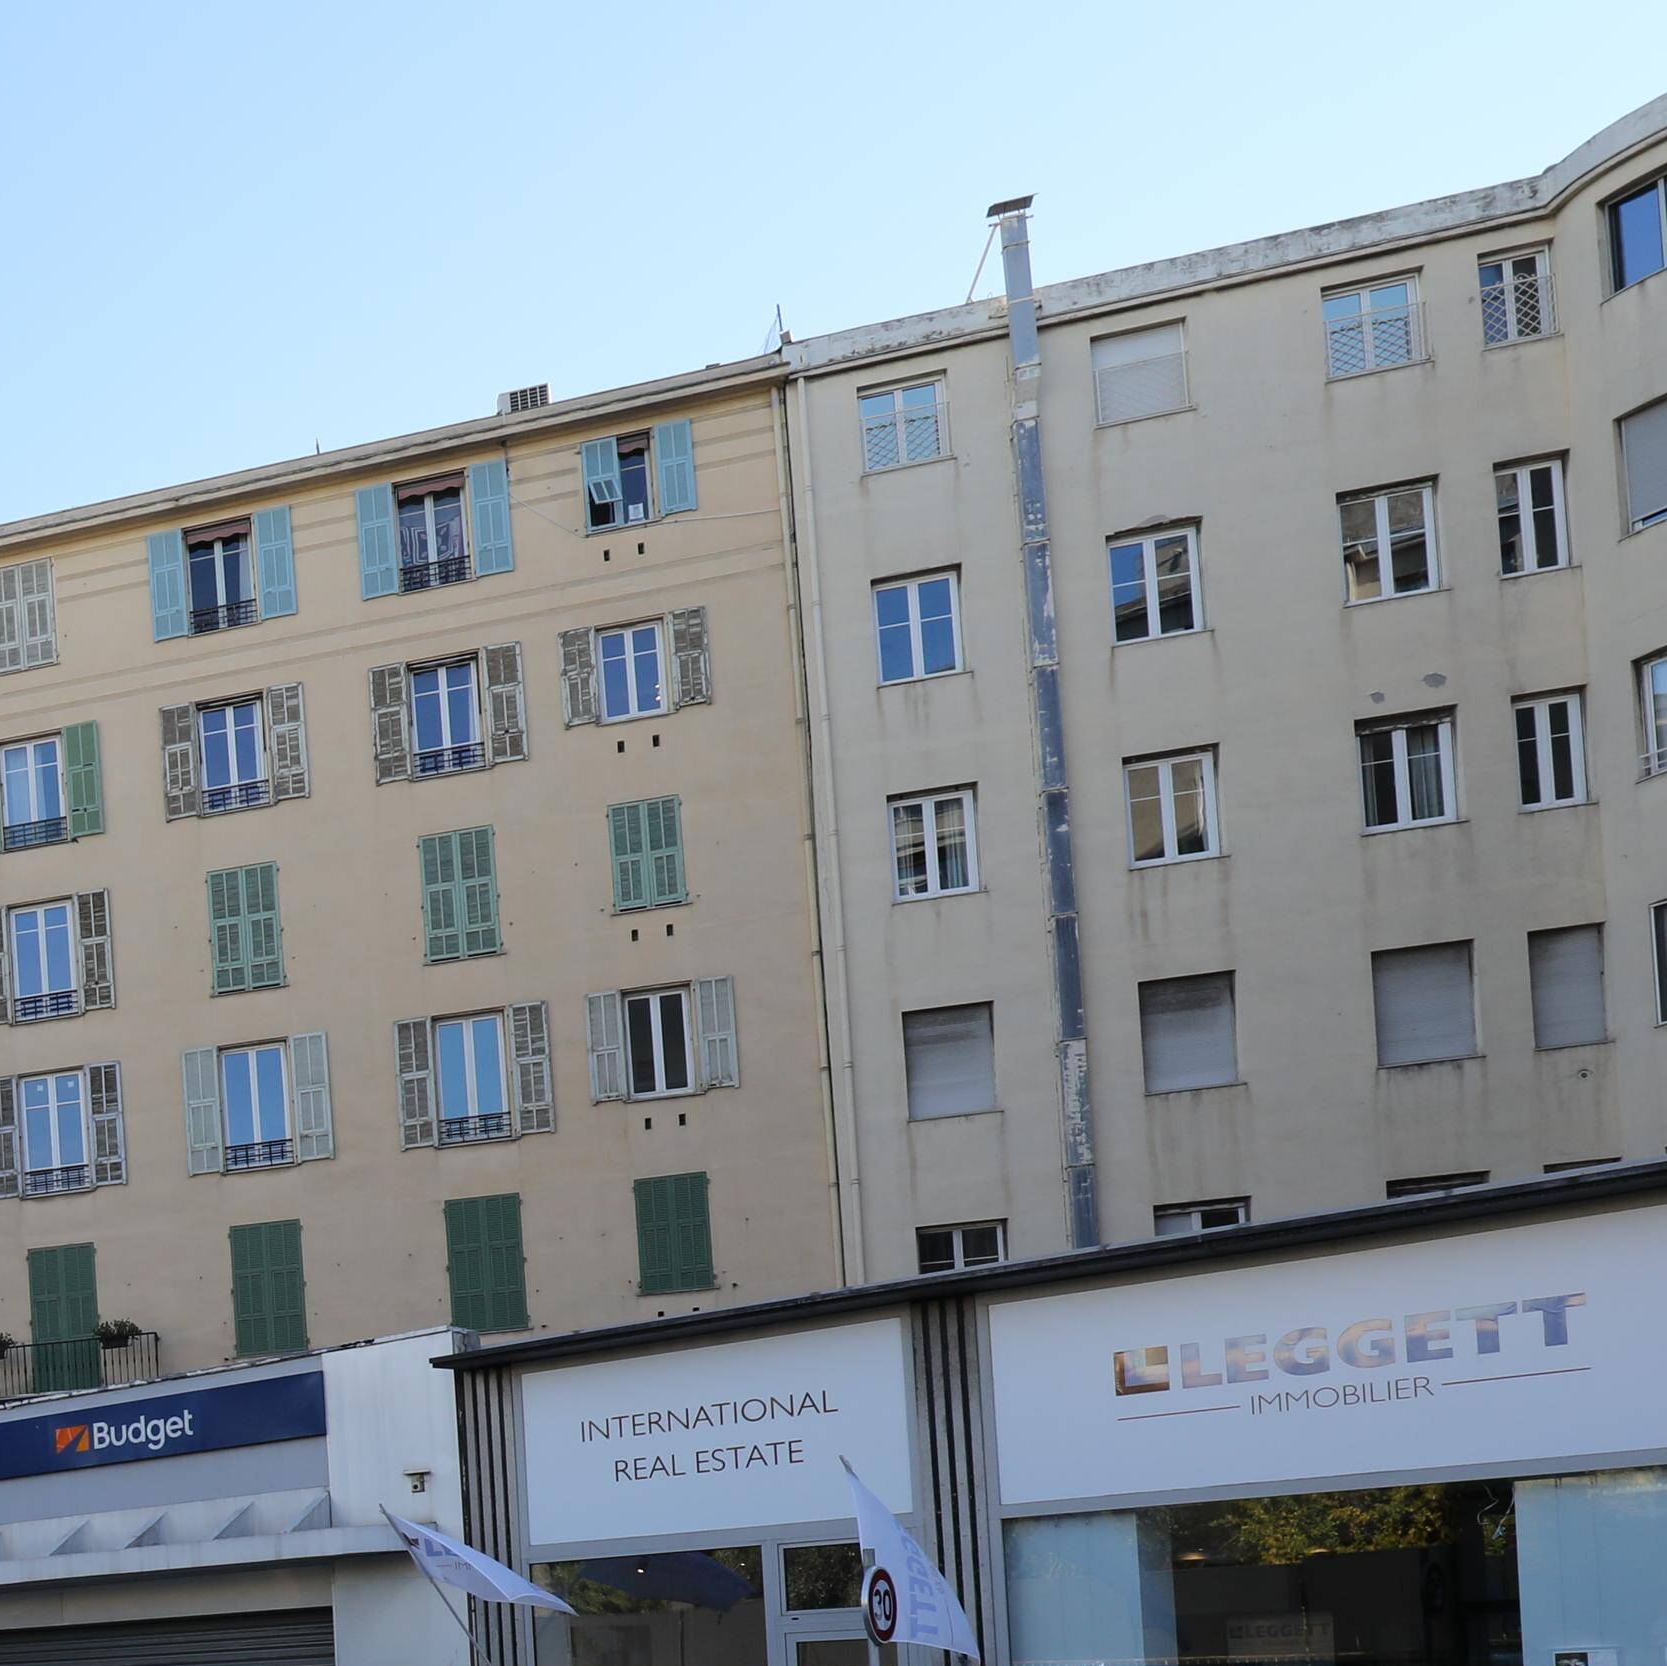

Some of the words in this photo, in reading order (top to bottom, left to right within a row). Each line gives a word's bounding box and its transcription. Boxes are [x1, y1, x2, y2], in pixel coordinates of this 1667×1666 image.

[1179, 1292, 1587, 1390] LEGGETT
[579, 1389, 839, 1443] INTERNATIONAL
[1249, 1376, 1435, 1416] IMMOBILIER
[93, 1409, 194, 1450] Budget
[614, 1451, 686, 1483] REAL
[695, 1438, 805, 1475] ESTATE
[873, 1588, 892, 1621] 30
